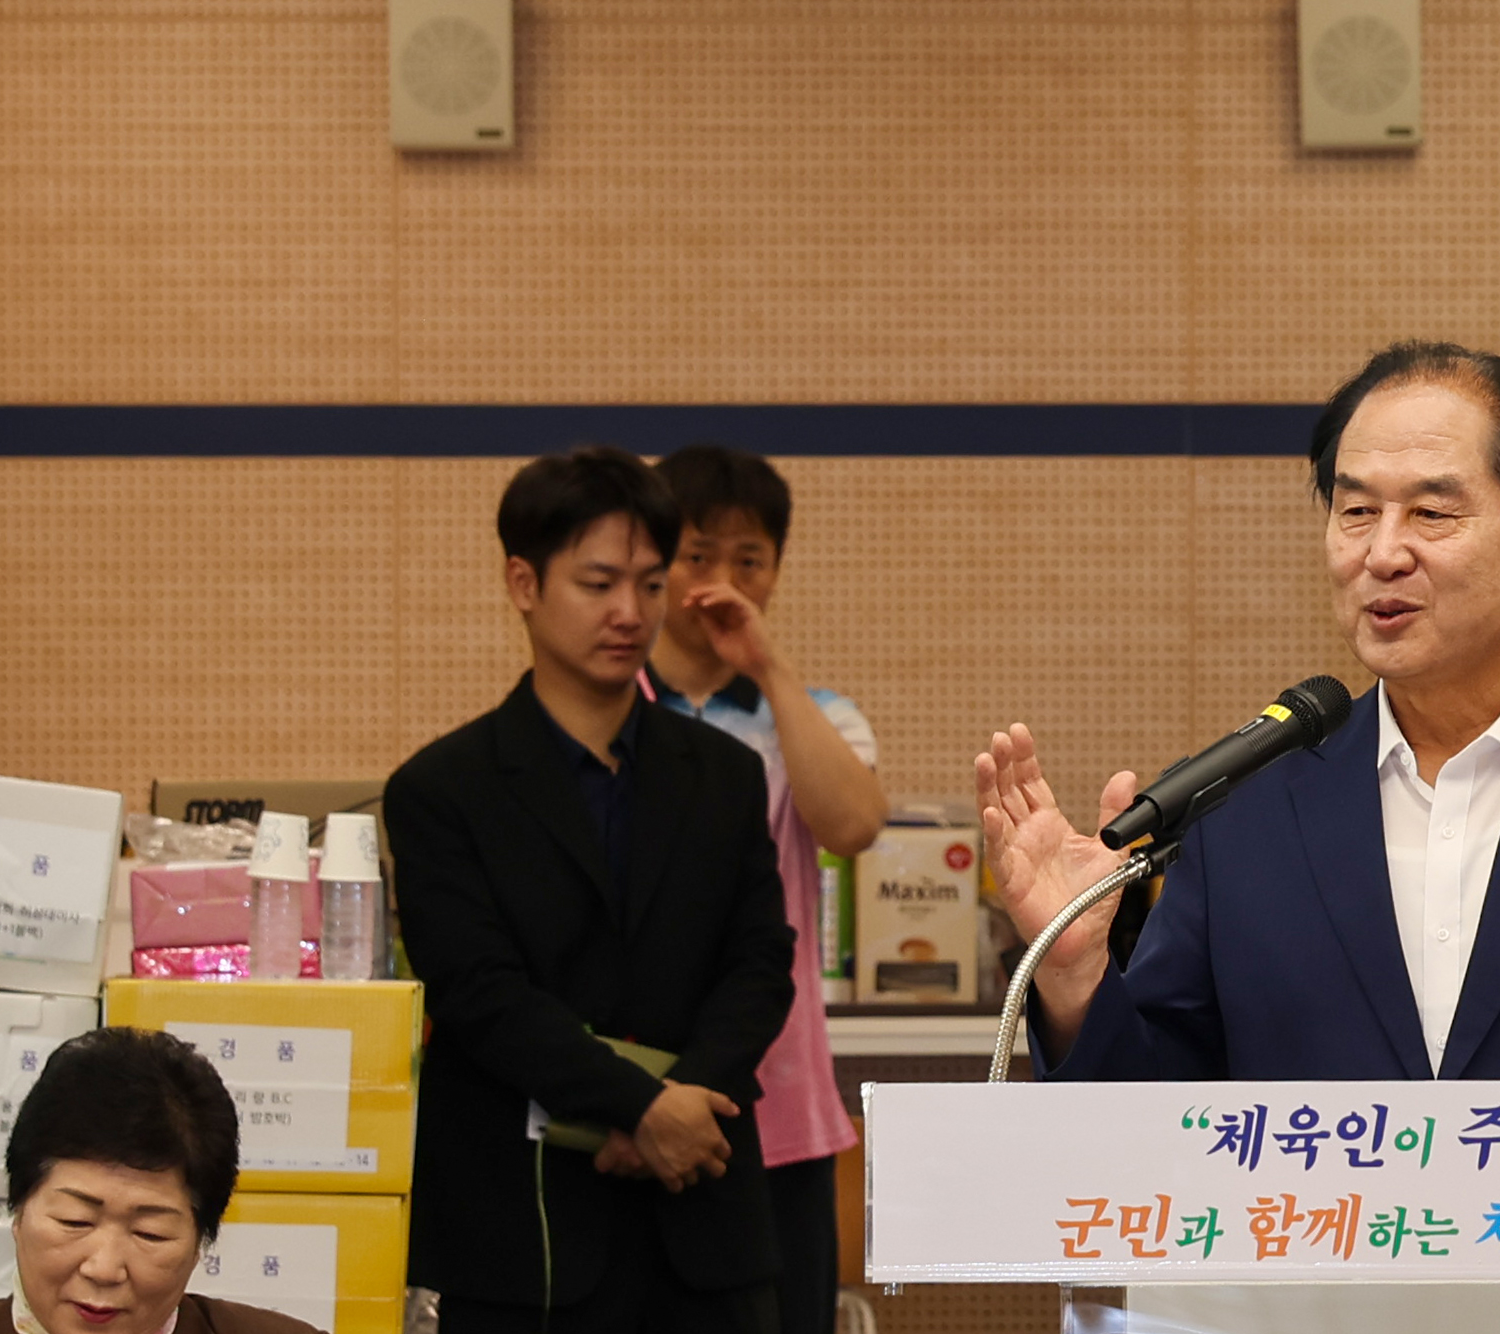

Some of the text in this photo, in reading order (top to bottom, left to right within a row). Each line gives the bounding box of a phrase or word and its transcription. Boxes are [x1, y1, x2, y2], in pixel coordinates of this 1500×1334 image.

[879, 880, 960, 901] Maxim
[1180, 1103, 1437, 1172] “체육인이
[1054, 1192, 1225, 1260] 군민과
[1245, 1192, 1460, 1261] 함께하는
